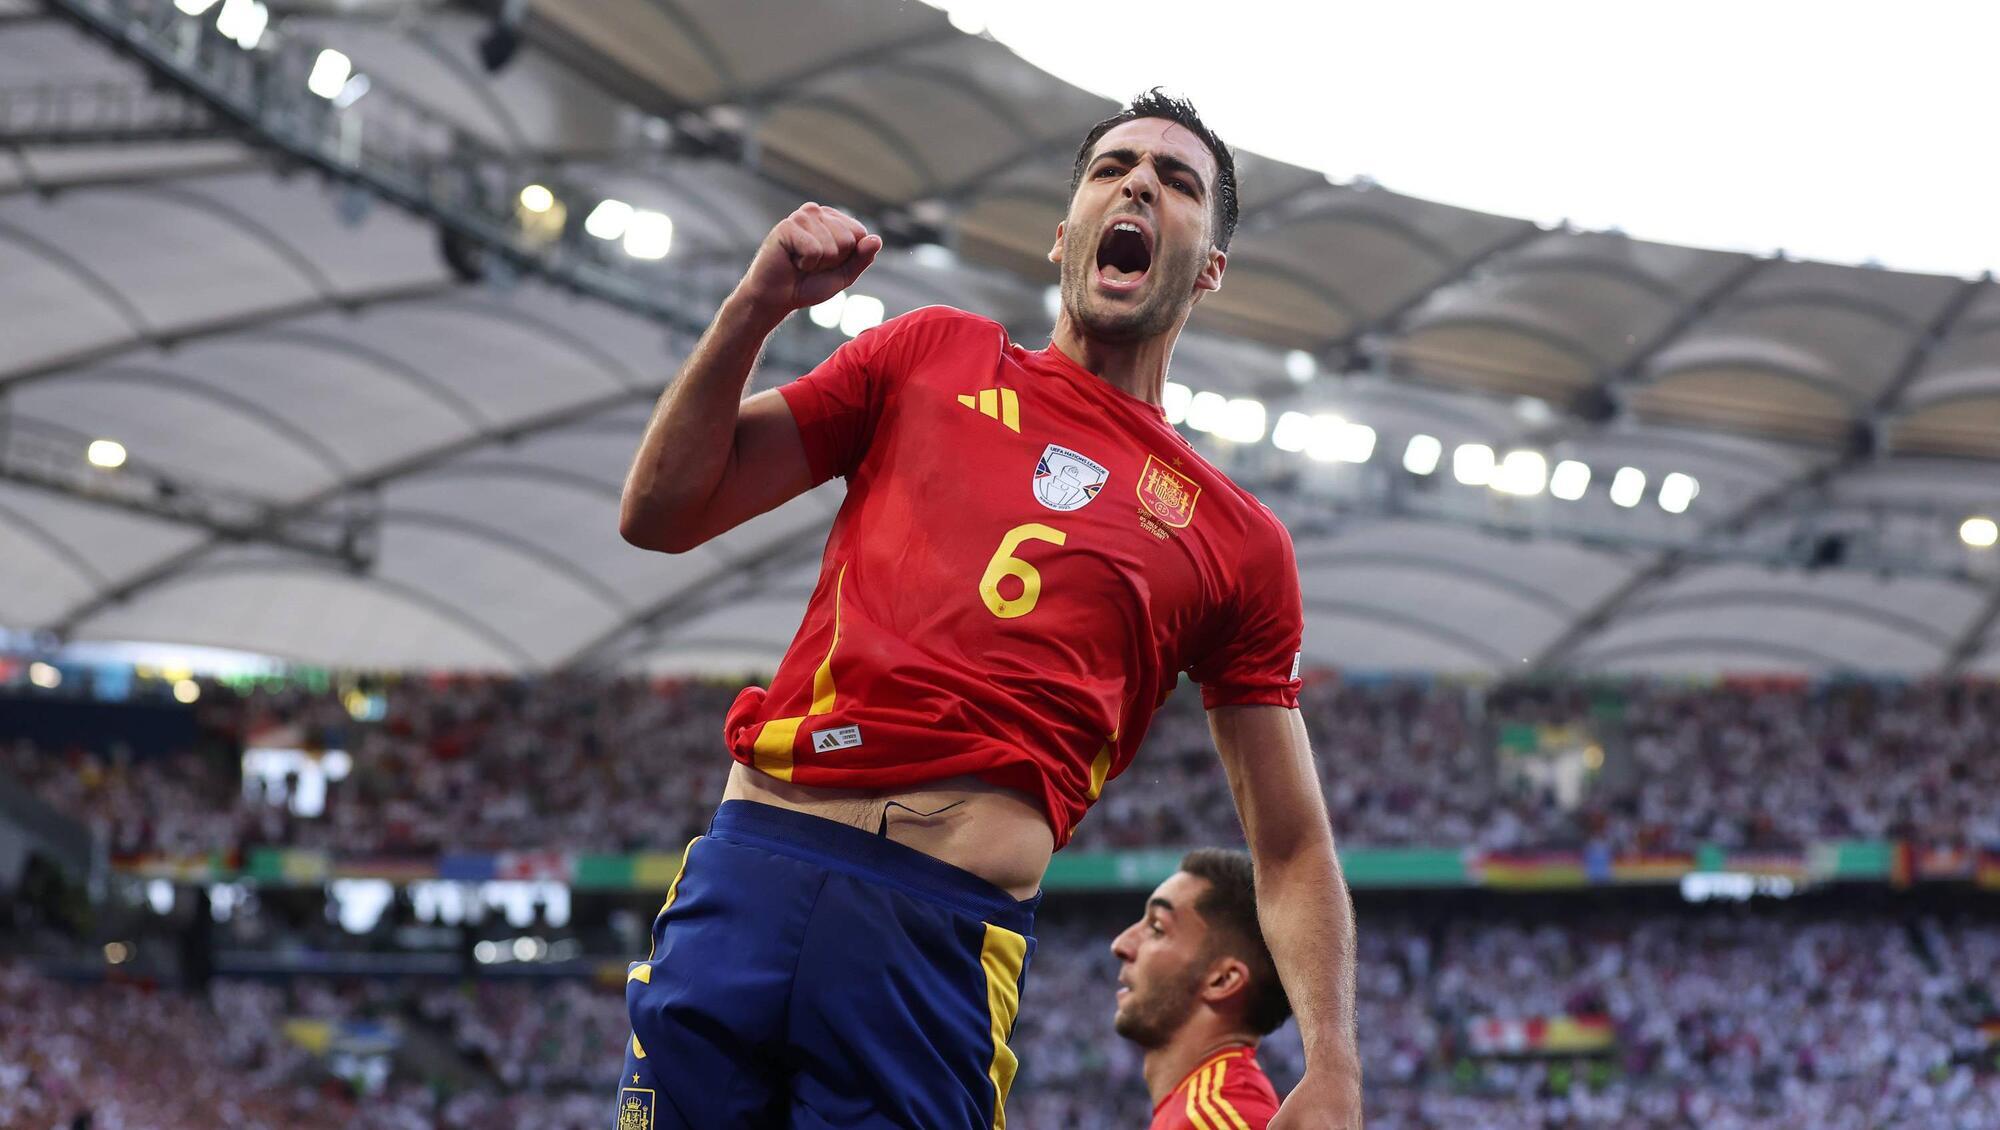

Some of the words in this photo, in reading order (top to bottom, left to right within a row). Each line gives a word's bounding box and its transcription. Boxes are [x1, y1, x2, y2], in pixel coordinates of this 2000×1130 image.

[1050, 446, 1063, 454] UEFA
[1064, 450, 1087, 464] NATIONS
[1086, 460, 1106, 475] LEAGUE
[979, 523, 1067, 618] 6
